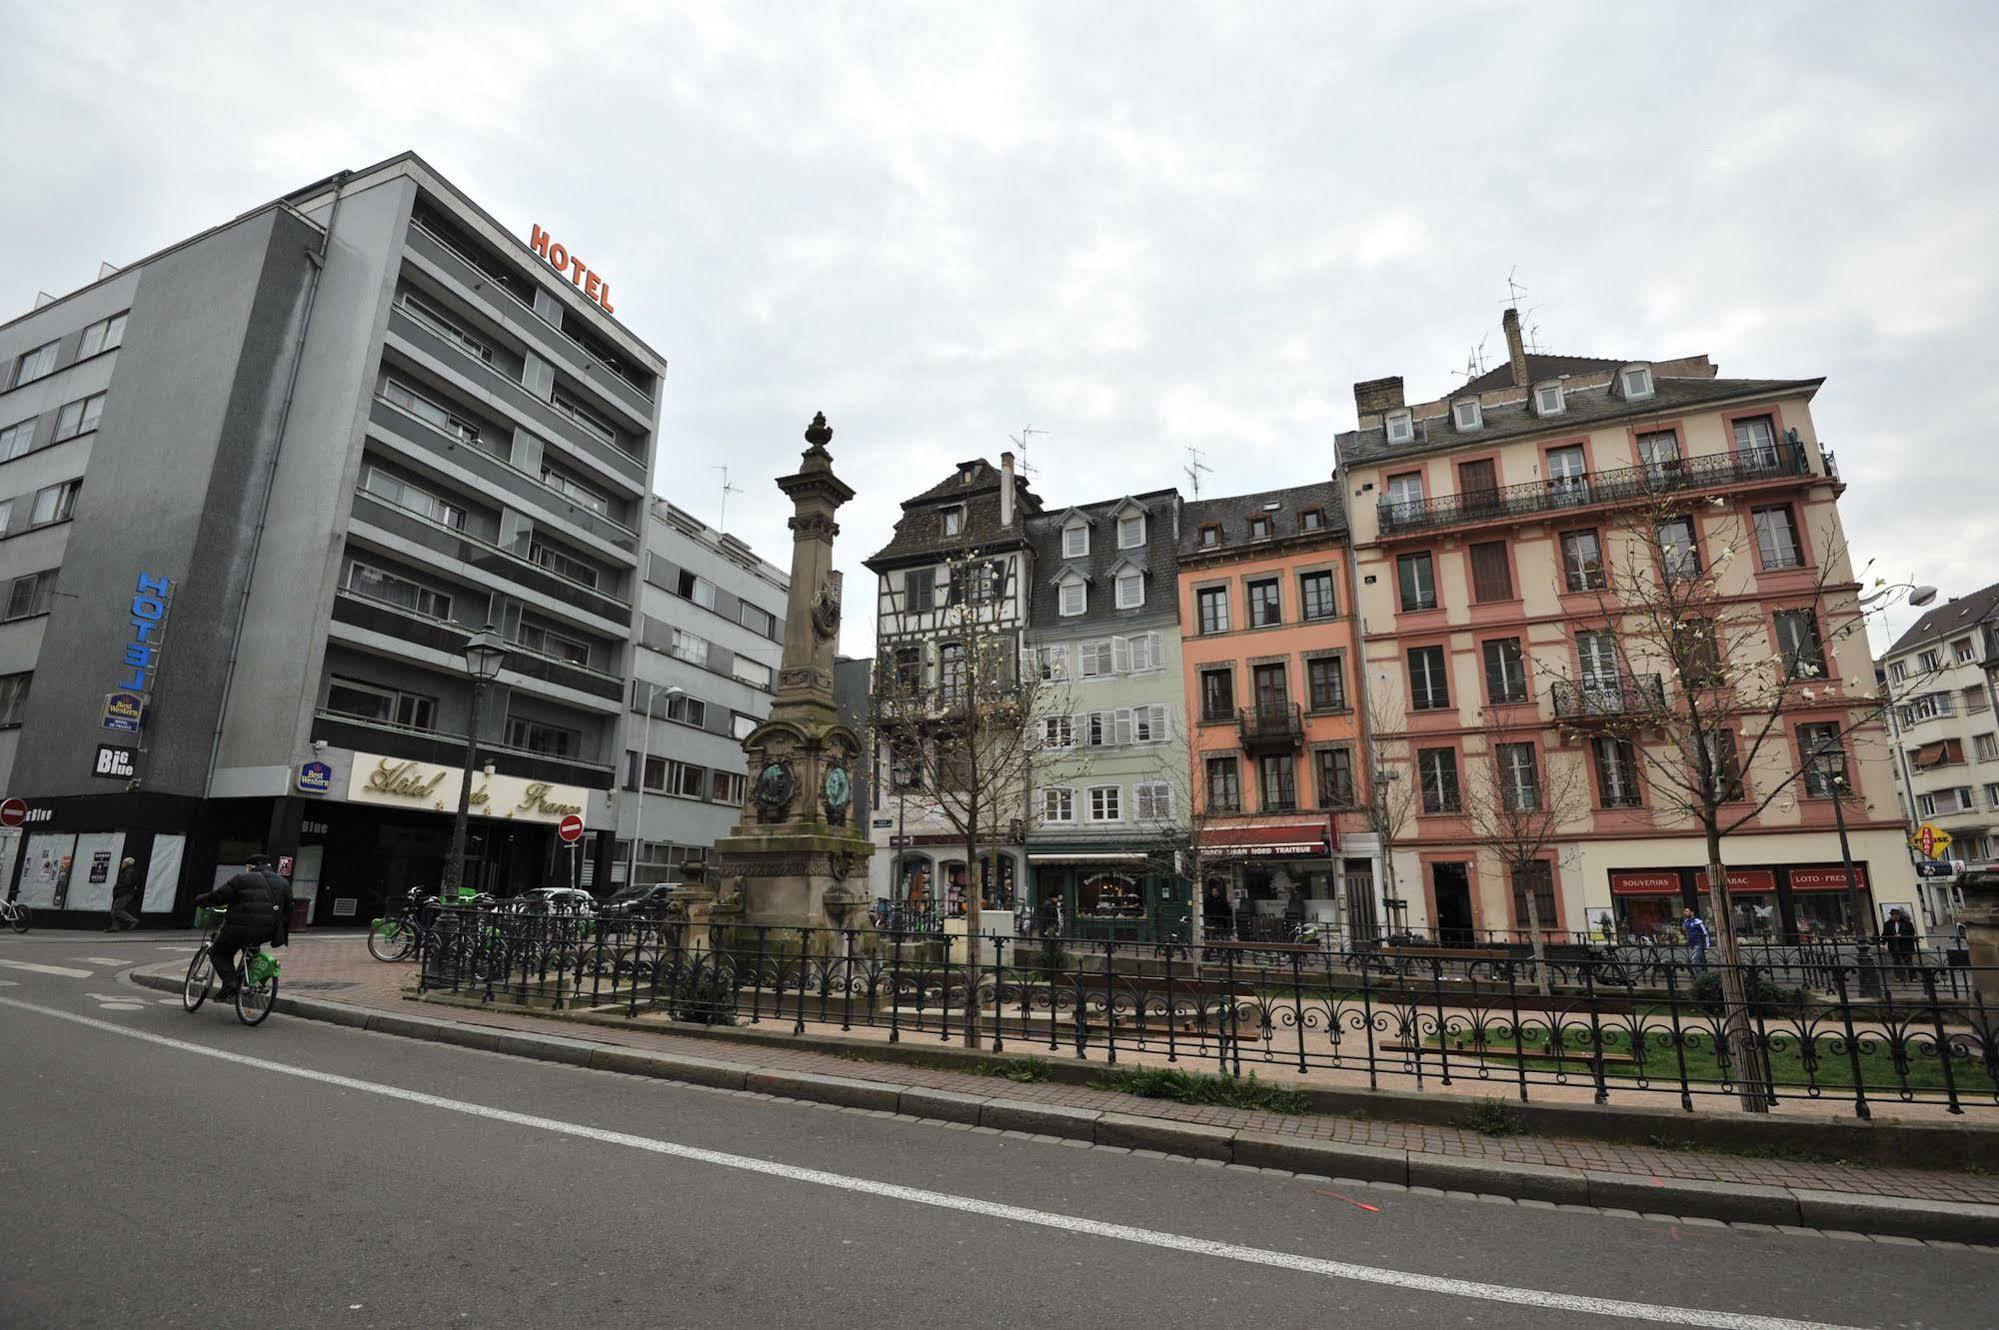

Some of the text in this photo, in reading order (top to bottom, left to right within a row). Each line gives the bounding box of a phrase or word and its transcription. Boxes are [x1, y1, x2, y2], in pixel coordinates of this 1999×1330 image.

[530, 223, 615, 314] HOTEL
[117, 571, 170, 691] HOTEL
[116, 701, 132, 710] Best
[110, 706, 139, 717] Western
[308, 770, 324, 779] Best
[301, 775, 329, 787] Western
[469, 784, 491, 805] de
[517, 783, 582, 816] France
[1251, 847, 1272, 855] NORD
[1275, 846, 1311, 854] TRAITEUR
[1622, 878, 1669, 887] SOUVENIRS
[1726, 877, 1749, 885] ABAC
[1796, 874, 1856, 883] LOTO PRES
